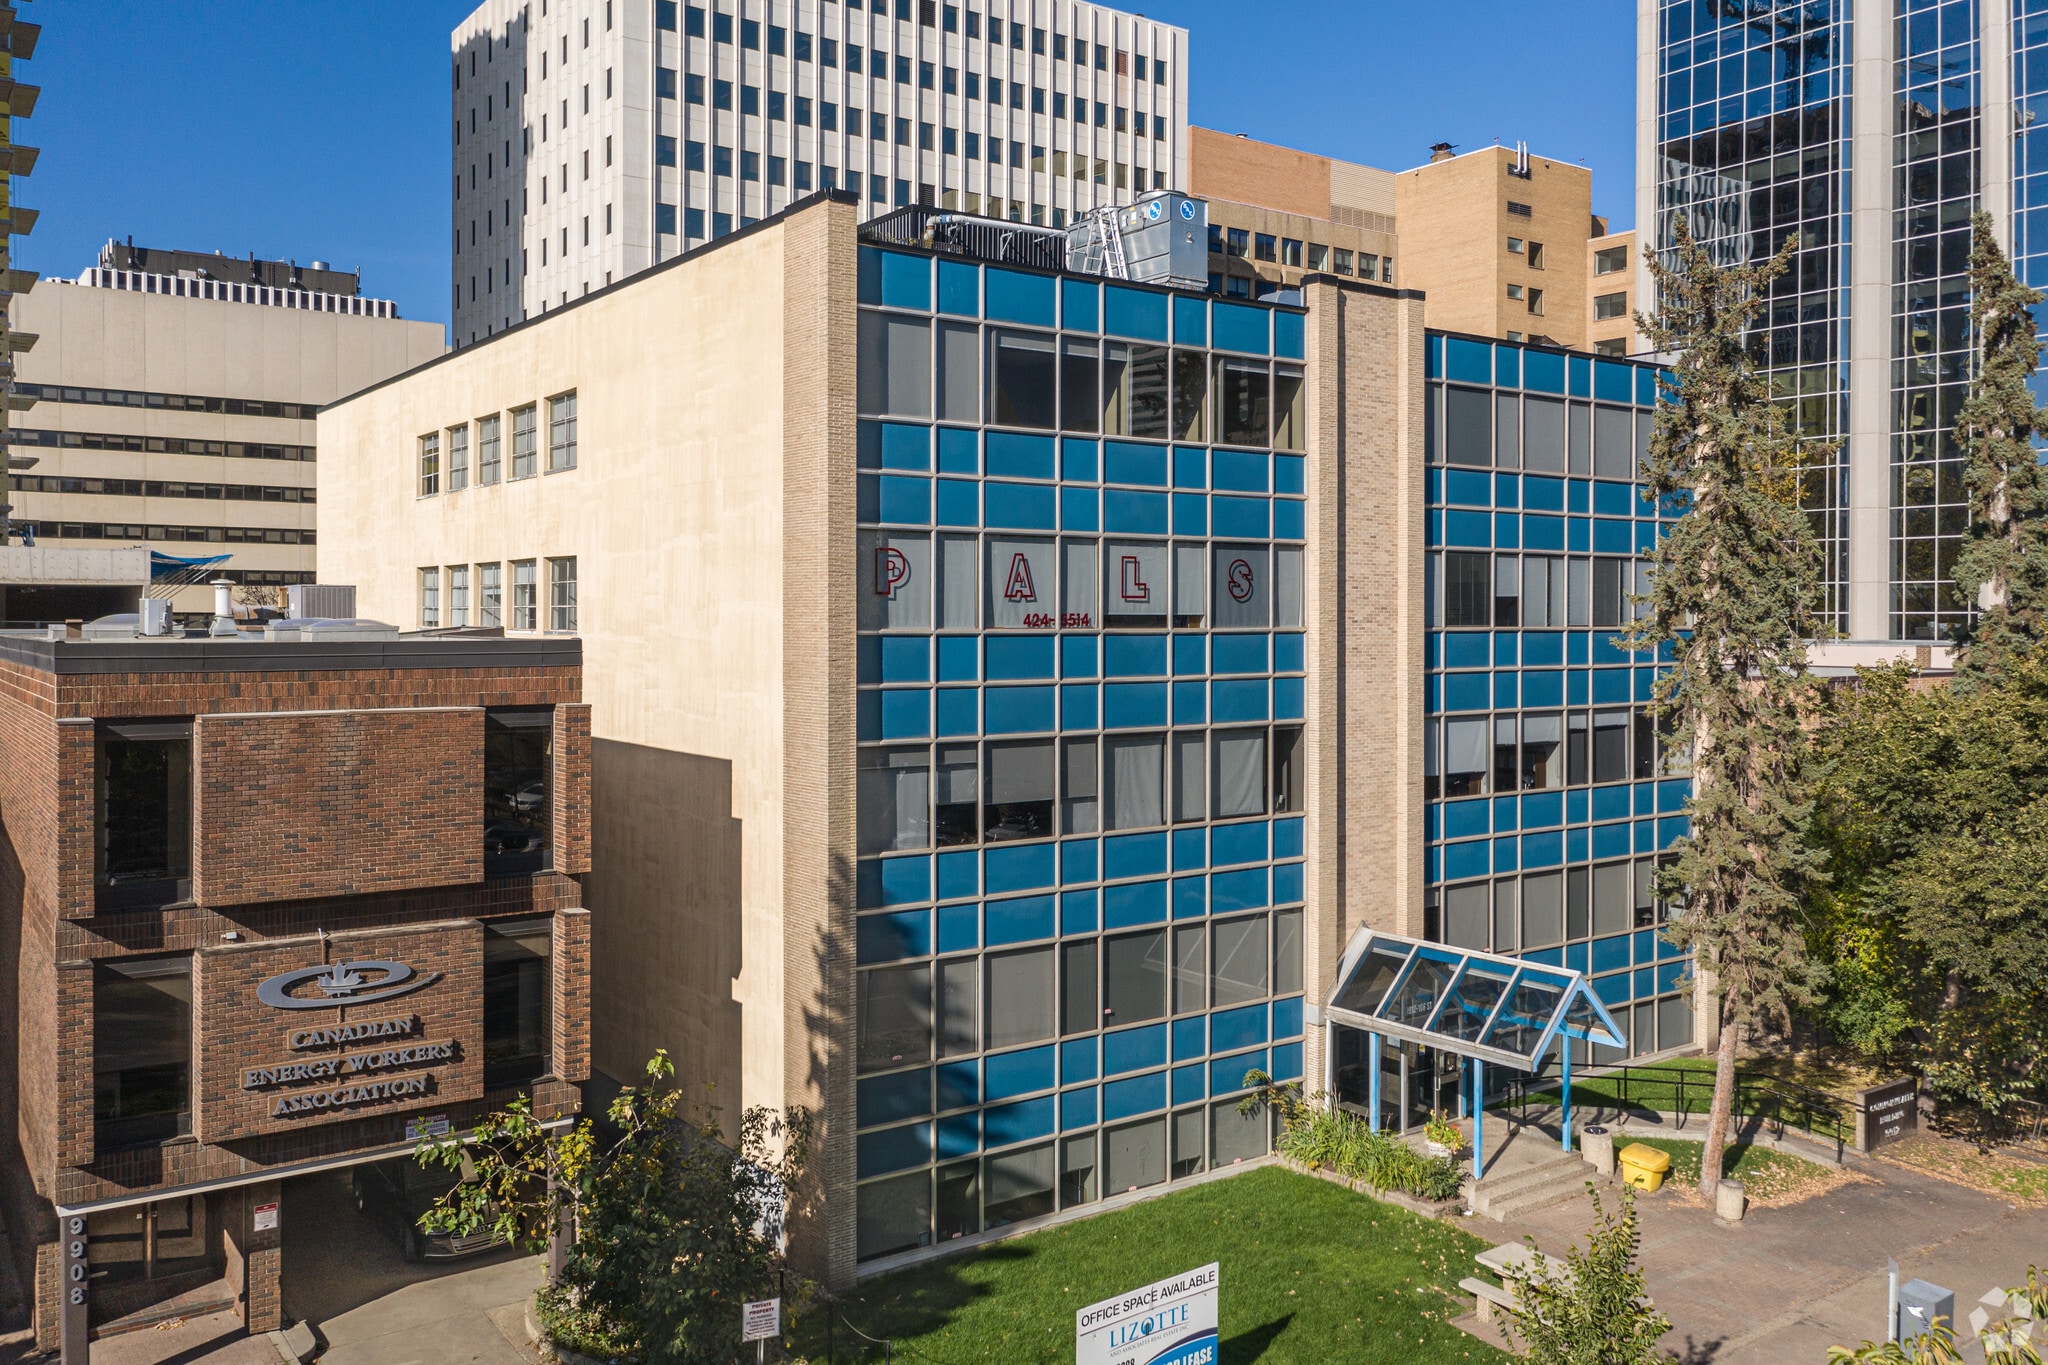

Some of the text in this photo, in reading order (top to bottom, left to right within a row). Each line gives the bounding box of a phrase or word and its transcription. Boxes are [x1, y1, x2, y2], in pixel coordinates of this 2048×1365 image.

[291, 1016, 413, 1048] CANADIAN
[244, 1042, 453, 1088] ENERGY WORKERS
[272, 1076, 427, 1116] ASSOCIATION
[69, 1217, 84, 1305] 9908
[749, 1307, 775, 1316] PROPERTY
[752, 1301, 772, 1309] PRIVATE
[1081, 1270, 1215, 1327] OFFICE SPACE AVAILABLE
[1110, 1303, 1189, 1348] LIZOTTE
[1182, 1345, 1213, 1365] LEASE
